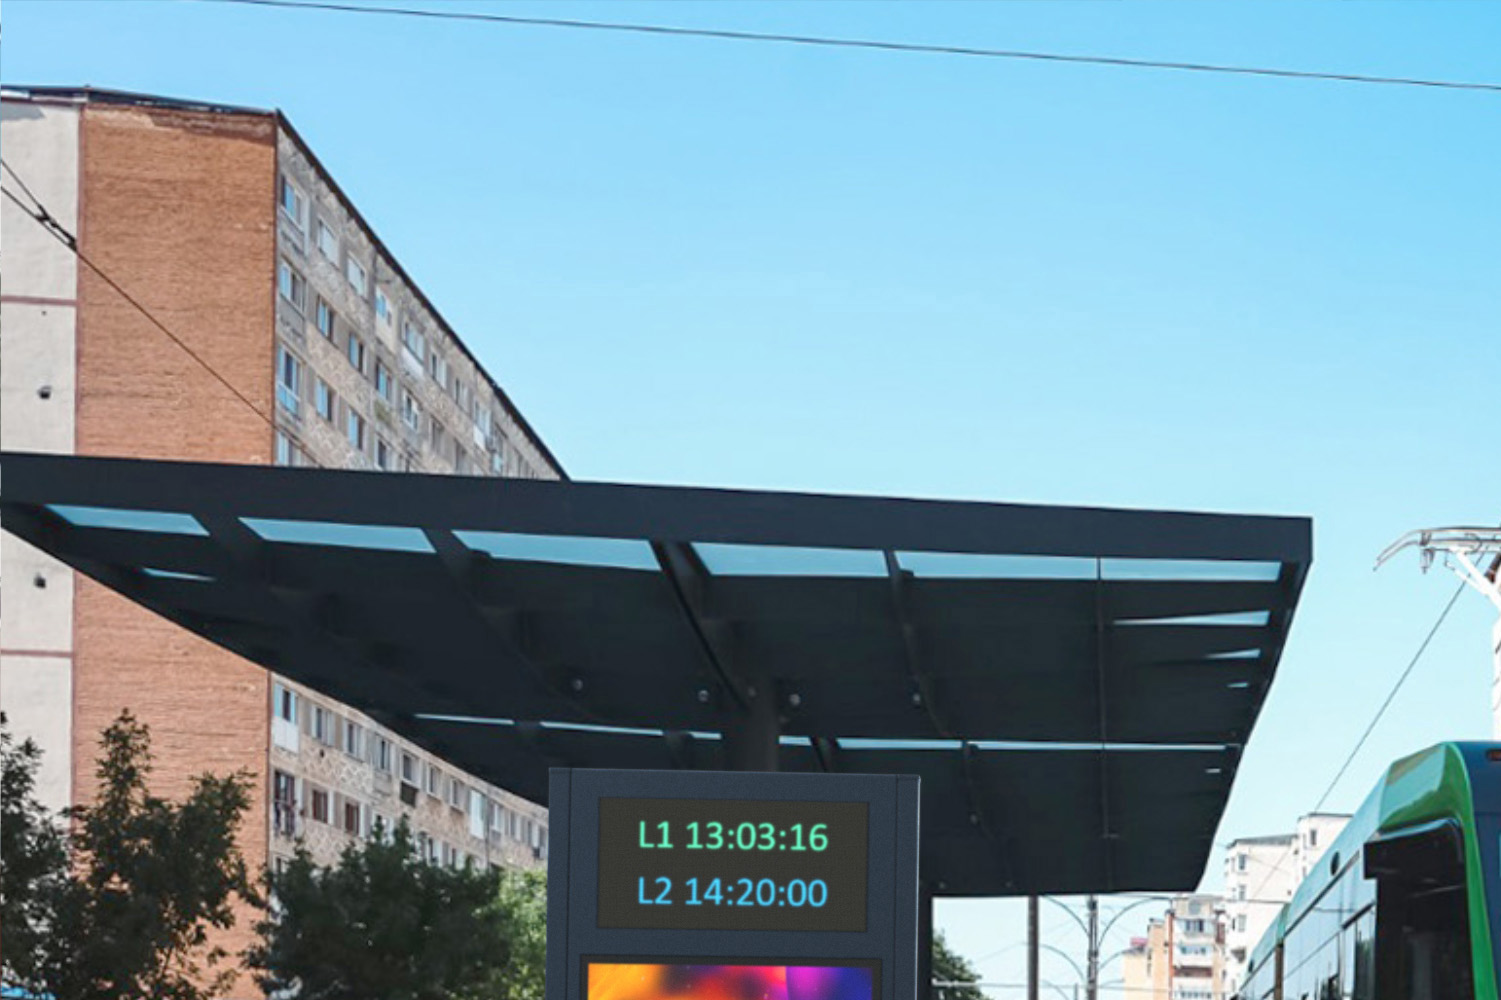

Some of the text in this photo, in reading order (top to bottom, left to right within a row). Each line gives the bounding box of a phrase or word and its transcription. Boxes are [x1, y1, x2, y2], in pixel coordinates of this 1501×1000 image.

[638, 820, 829, 852] L1 13:03:16
[638, 876, 828, 908] L2 14:20:00
